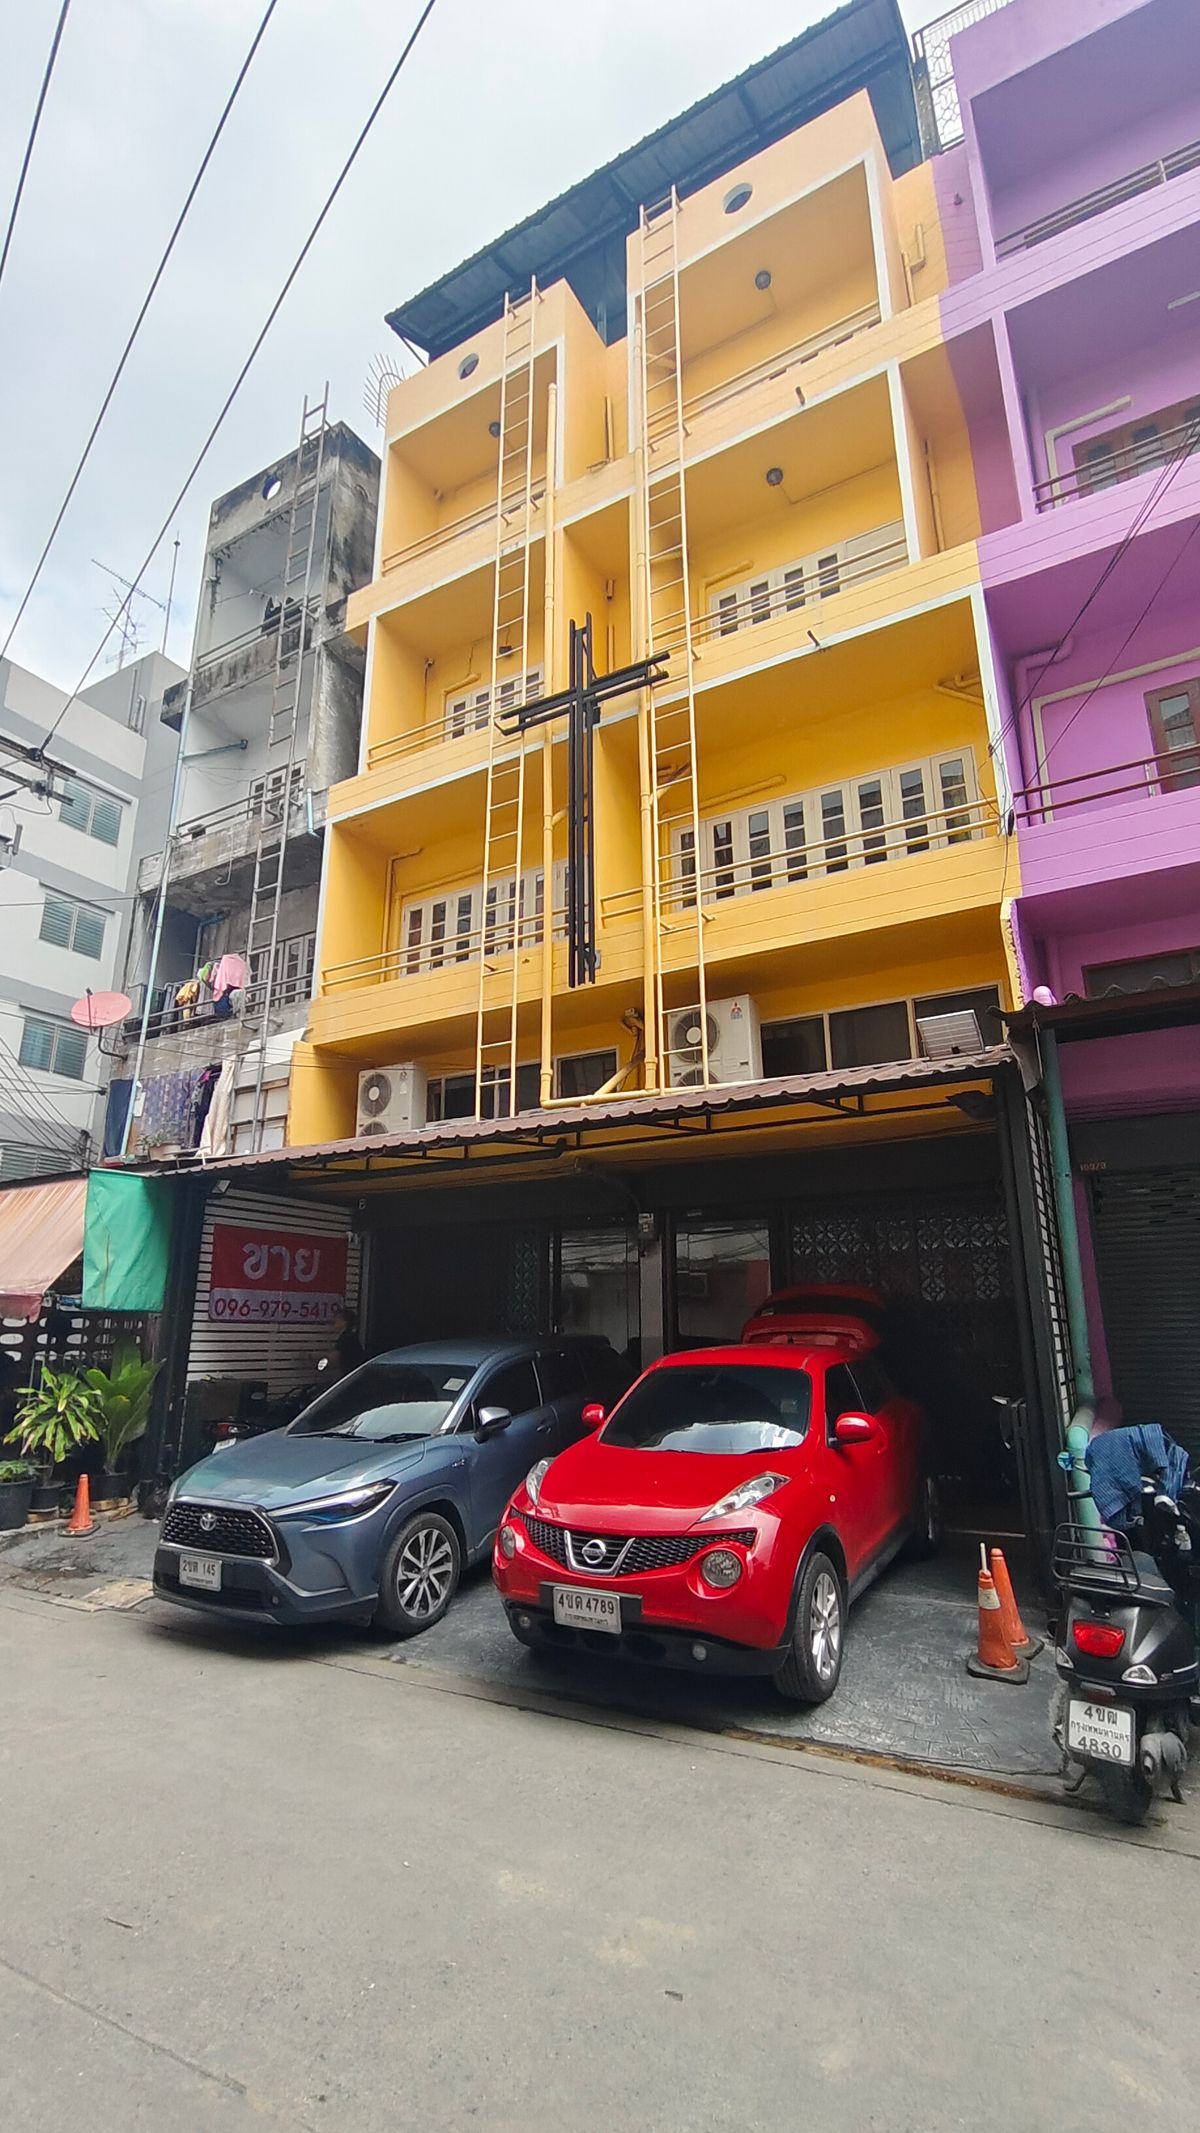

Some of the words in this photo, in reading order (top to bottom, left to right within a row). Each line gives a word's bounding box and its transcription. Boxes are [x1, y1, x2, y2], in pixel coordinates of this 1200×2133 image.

[242, 1242, 321, 1283] ขาย
[214, 1297, 342, 1320] 096-979-5419
[586, 1597, 615, 1615] 4789
[1077, 1735, 1122, 1759] 4830
